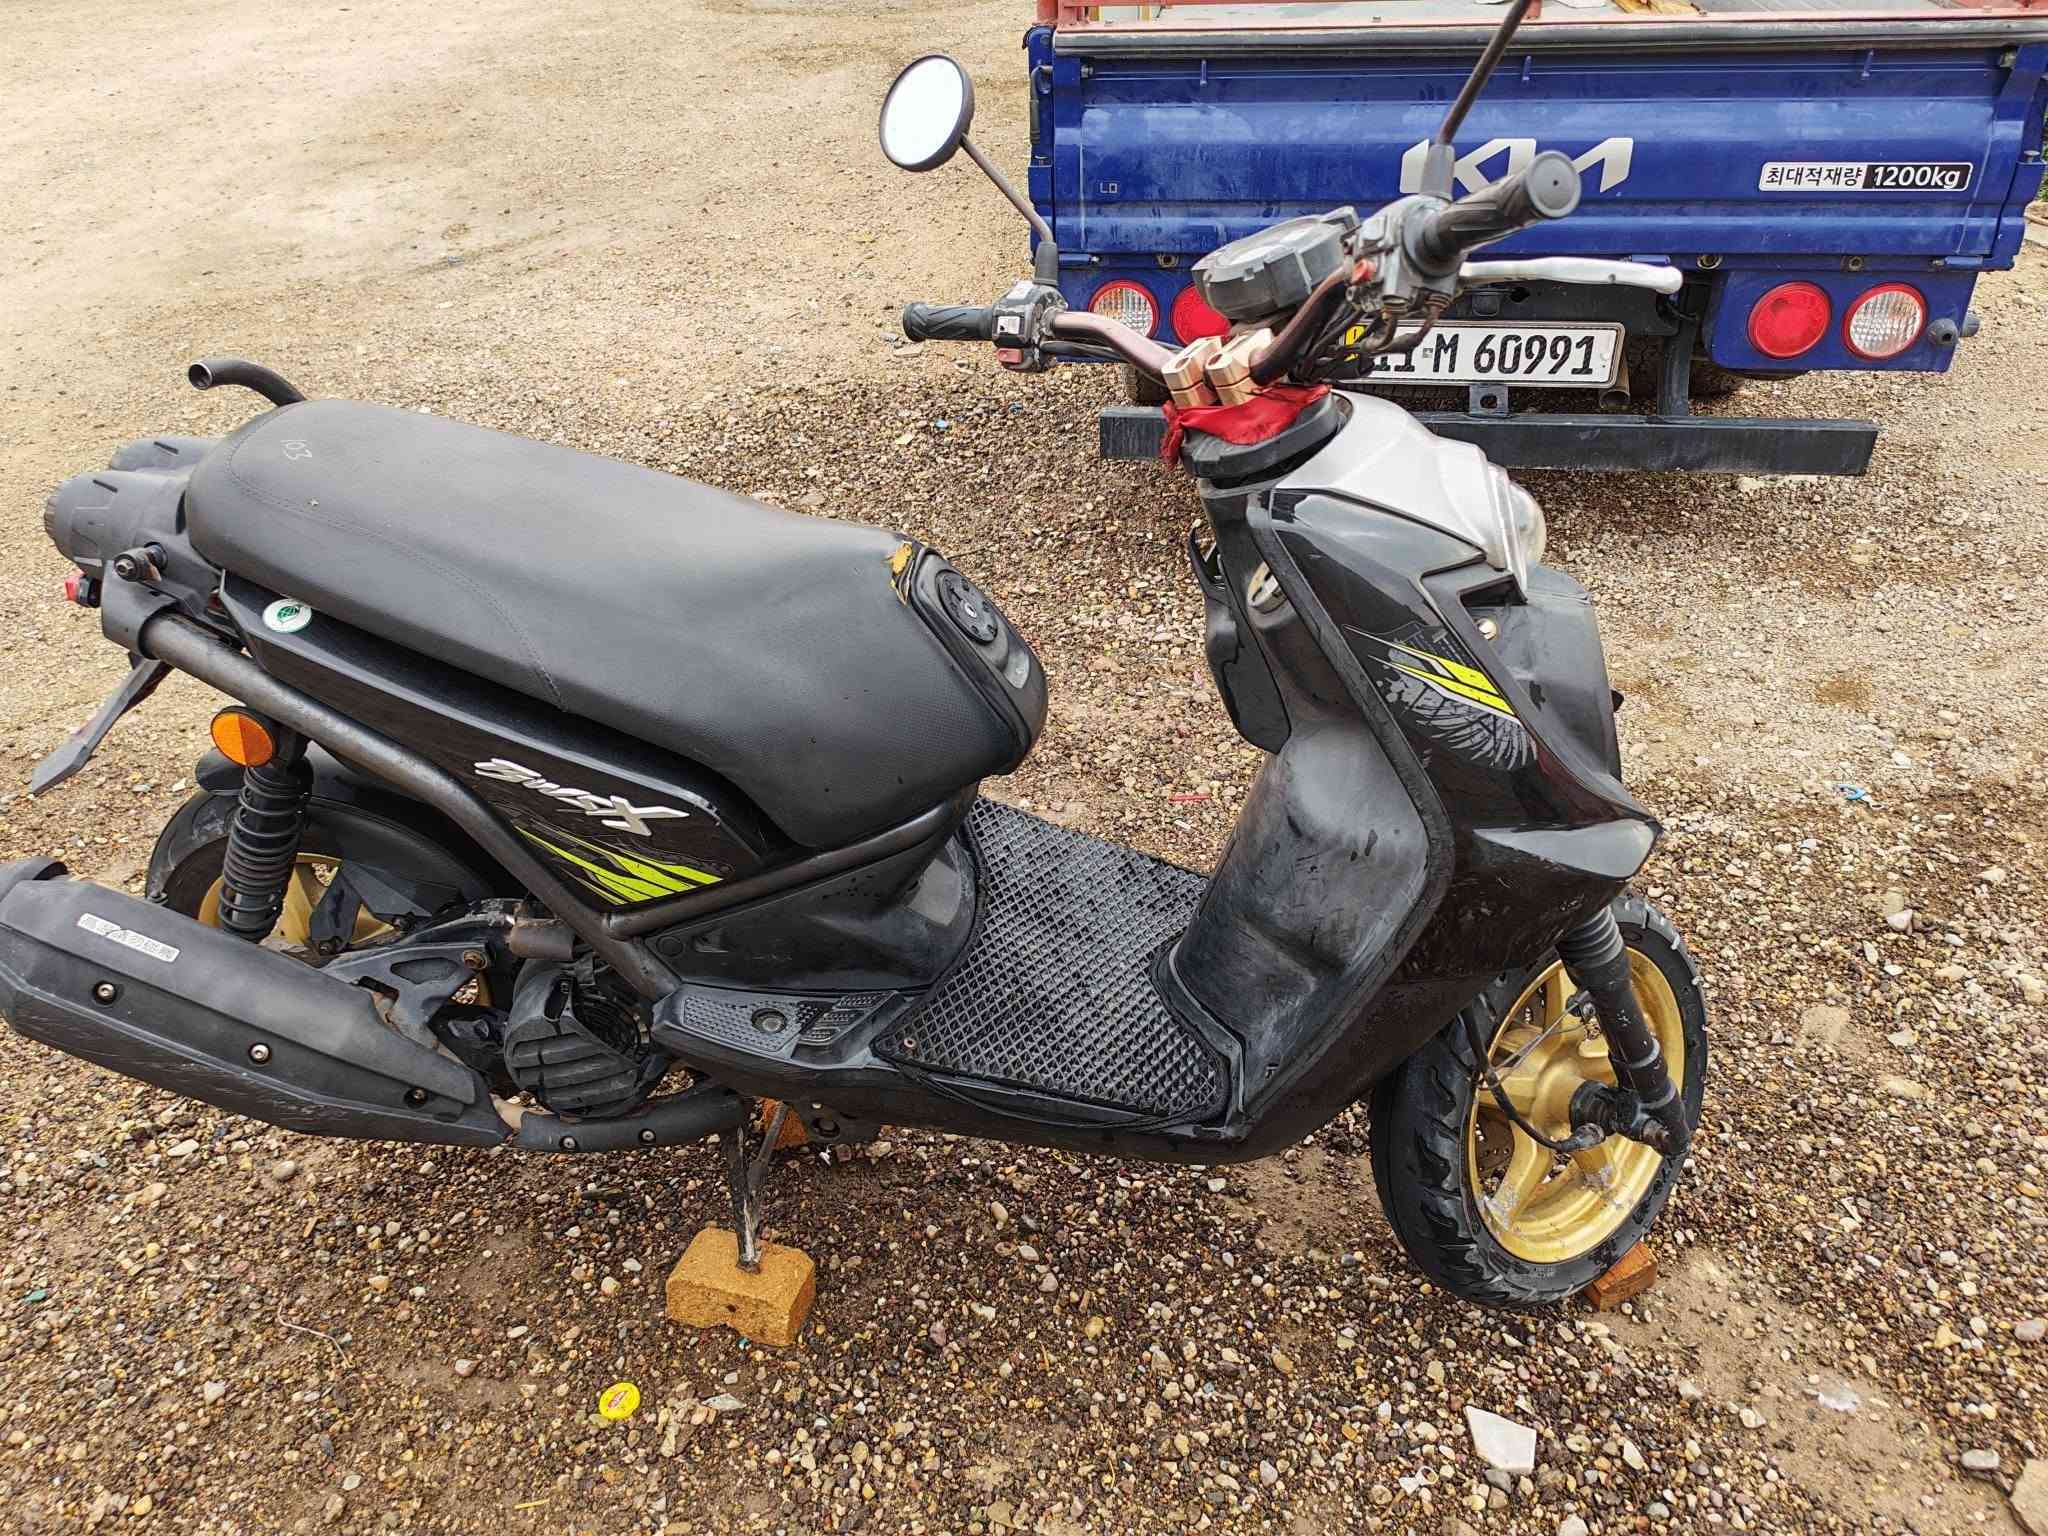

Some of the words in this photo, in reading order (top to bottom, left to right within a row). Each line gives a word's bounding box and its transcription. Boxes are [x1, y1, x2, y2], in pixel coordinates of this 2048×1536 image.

[1765, 167, 1863, 187] 최대적재량
[1874, 166, 1961, 189] 1200kg
[1432, 333, 1459, 373] M
[1473, 334, 1594, 375] 60991
